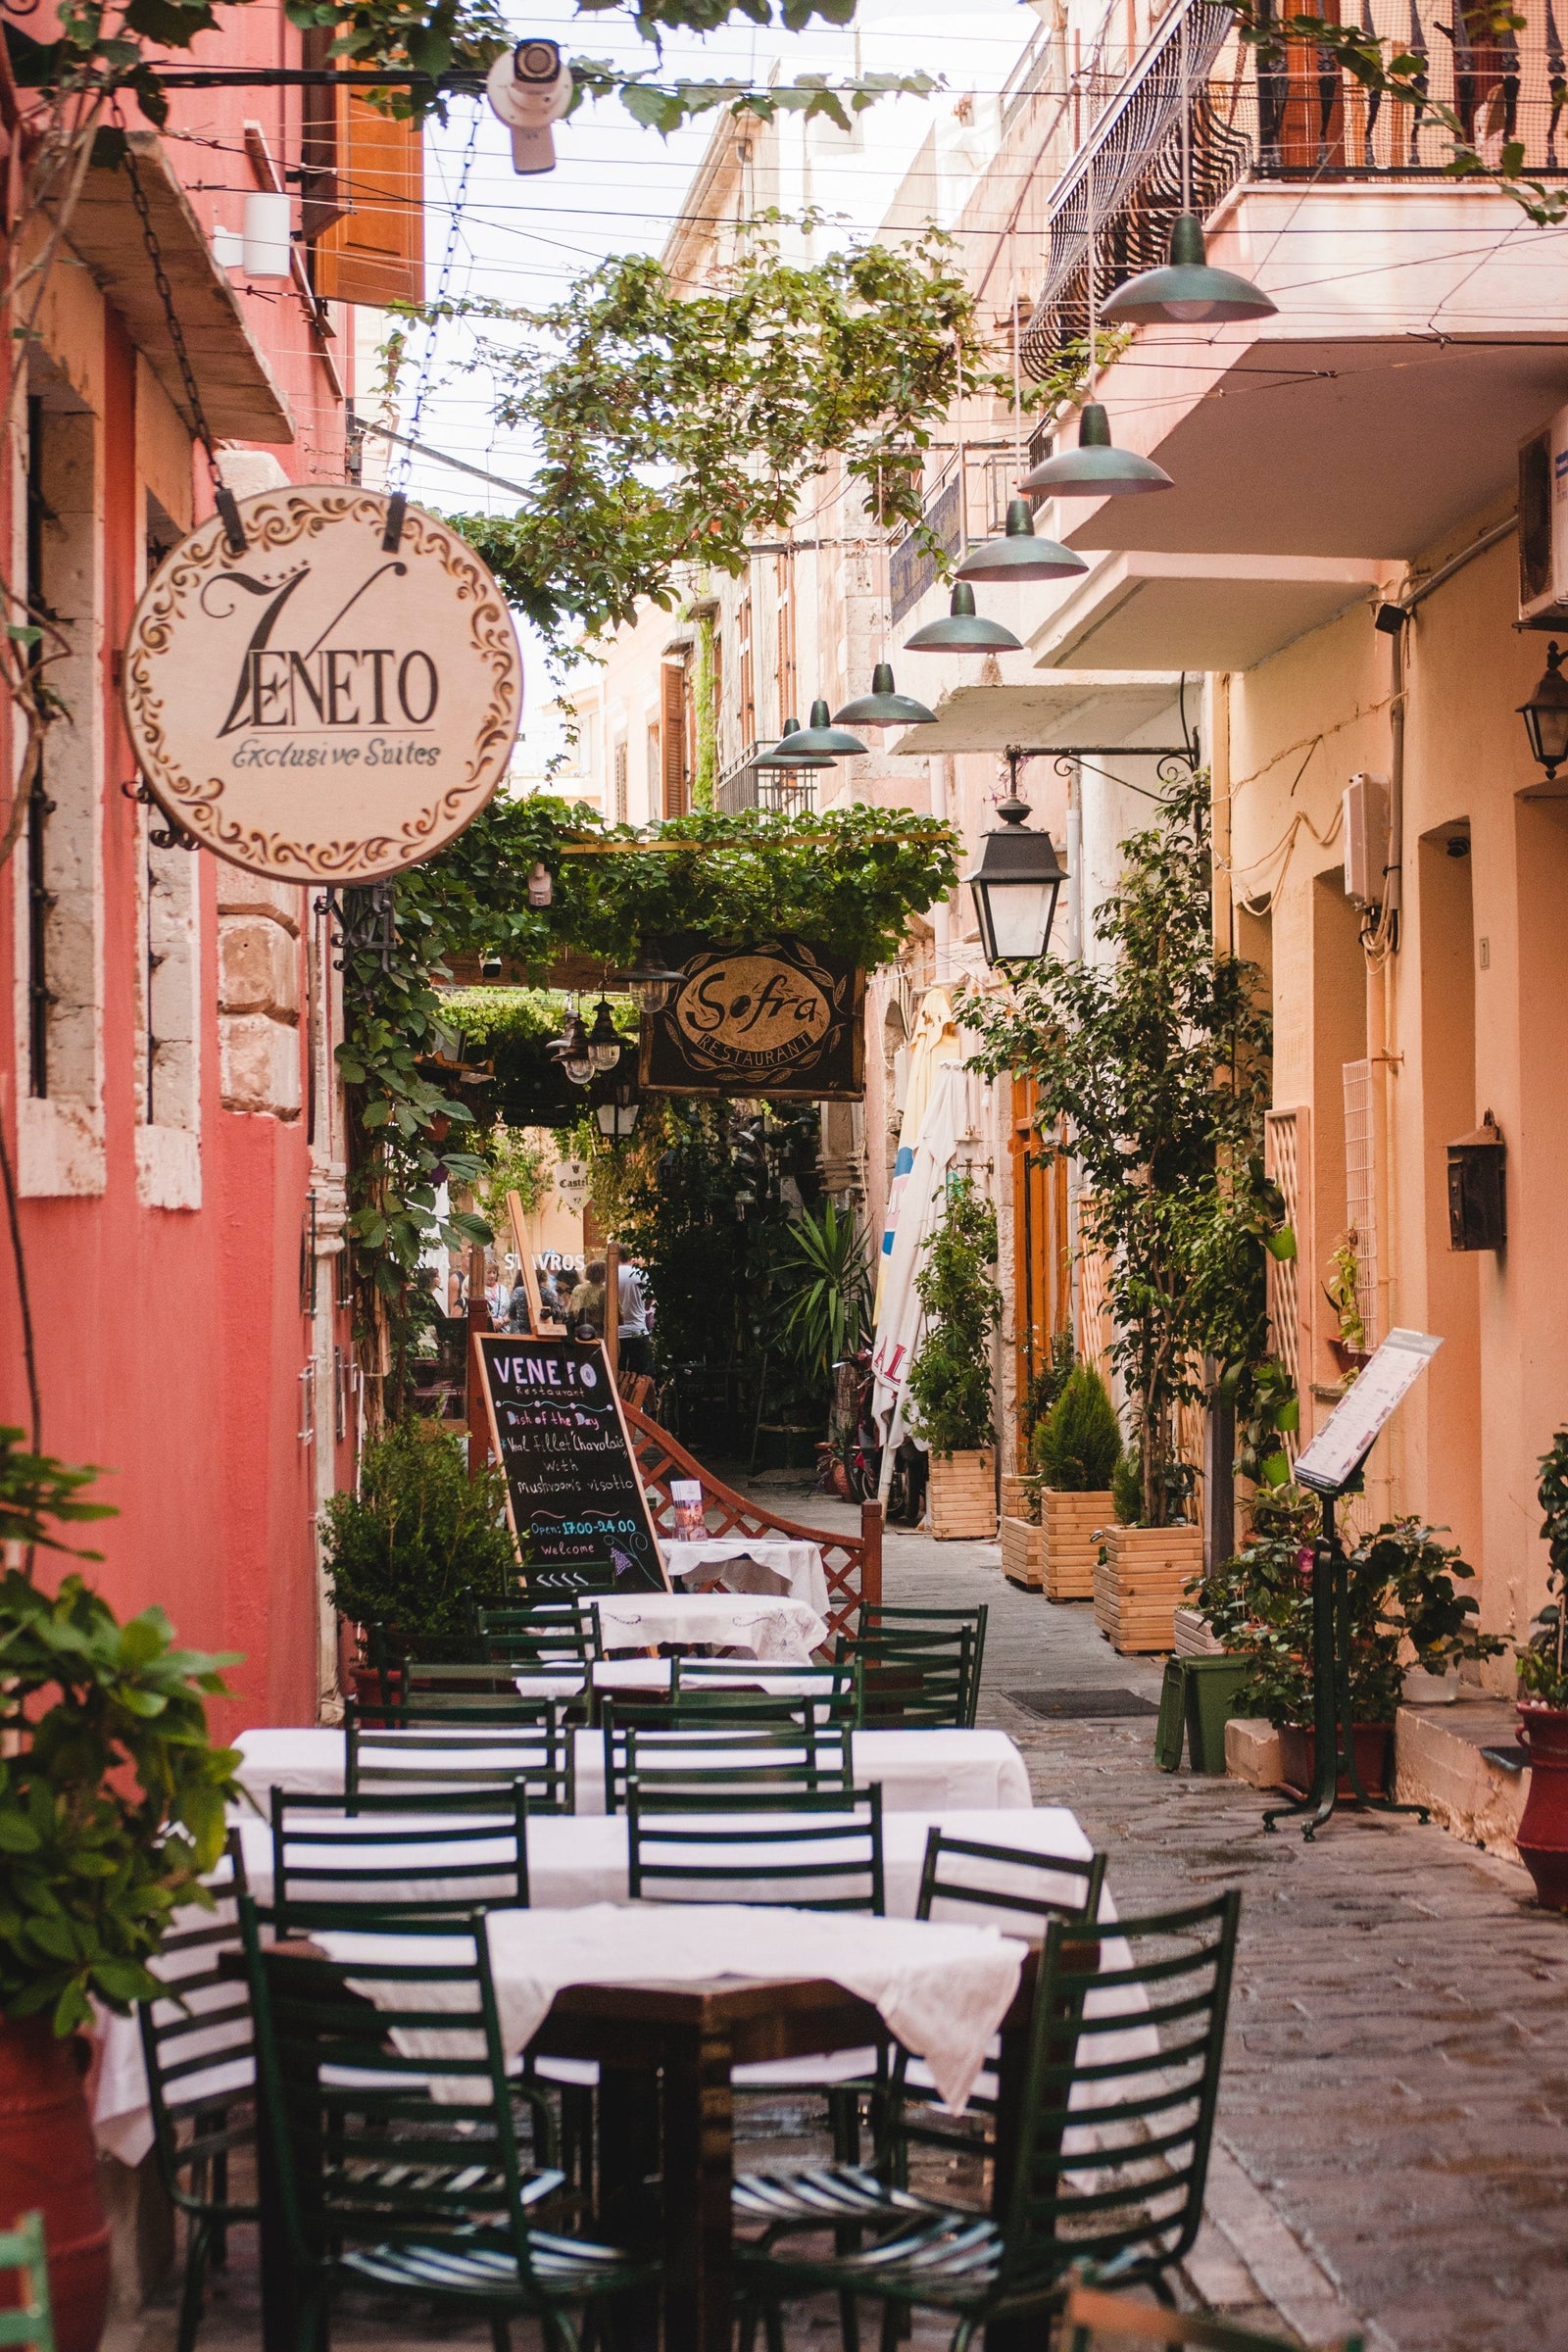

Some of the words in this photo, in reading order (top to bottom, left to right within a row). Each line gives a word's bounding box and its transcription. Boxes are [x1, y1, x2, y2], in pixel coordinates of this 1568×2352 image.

[201, 562, 439, 740] VENETO
[232, 739, 360, 768] Exclusive
[365, 737, 440, 766] Suites
[686, 971, 817, 1034] Sofra
[698, 1034, 810, 1066] RESTAURANT
[507, 1410, 532, 1426] Dish
[534, 1411, 547, 1426] of
[551, 1411, 572, 1427] the
[574, 1412, 600, 1431] Day
